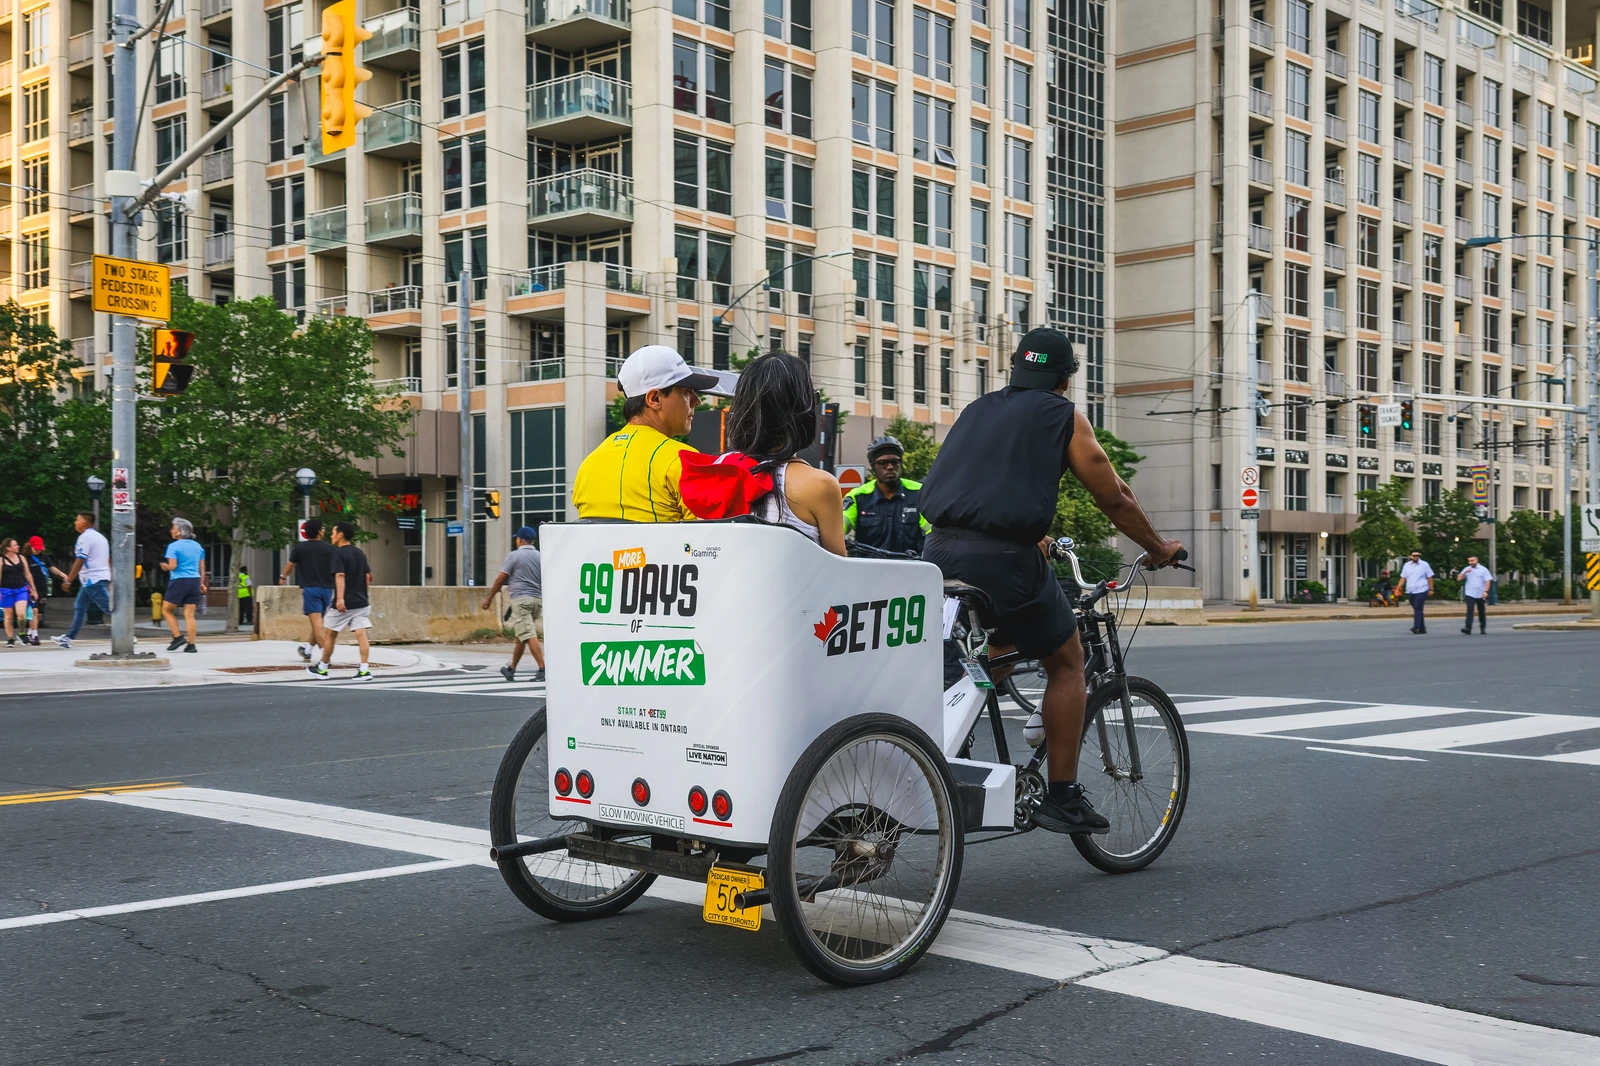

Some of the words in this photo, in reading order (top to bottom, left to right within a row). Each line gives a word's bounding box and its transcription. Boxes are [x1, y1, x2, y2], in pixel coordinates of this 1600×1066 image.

[104, 263, 125, 278] TWO
[130, 267, 159, 282] STAGE
[101, 278, 162, 297] PEDESTRIAN
[107, 295, 157, 312] CROSSING
[1025, 350, 1048, 364] BET99
[618, 551, 642, 569] MORE
[579, 563, 614, 614] 99
[620, 563, 699, 617] DAYS
[630, 619, 643, 634] OF
[820, 594, 926, 657] BET99
[588, 643, 696, 686] SUMMER
[617, 706, 637, 716] START
[638, 708, 647, 717] AT
[648, 708, 667, 720] BET99
[600, 717, 616, 728] ONLY
[617, 719, 650, 731] AVAILABLE
[651, 722, 659, 732] IN
[660, 723, 688, 735] ONTARIO
[688, 751, 703, 760] LIVE
[702, 753, 726, 763] NATION
[600, 806, 622, 818] SLOW
[623, 810, 654, 825] MOVING
[654, 814, 685, 830] VEHICLE
[711, 873, 730, 881] PEDICAB
[707, 912, 721, 920] CITY
[729, 917, 755, 926] TORONTO
